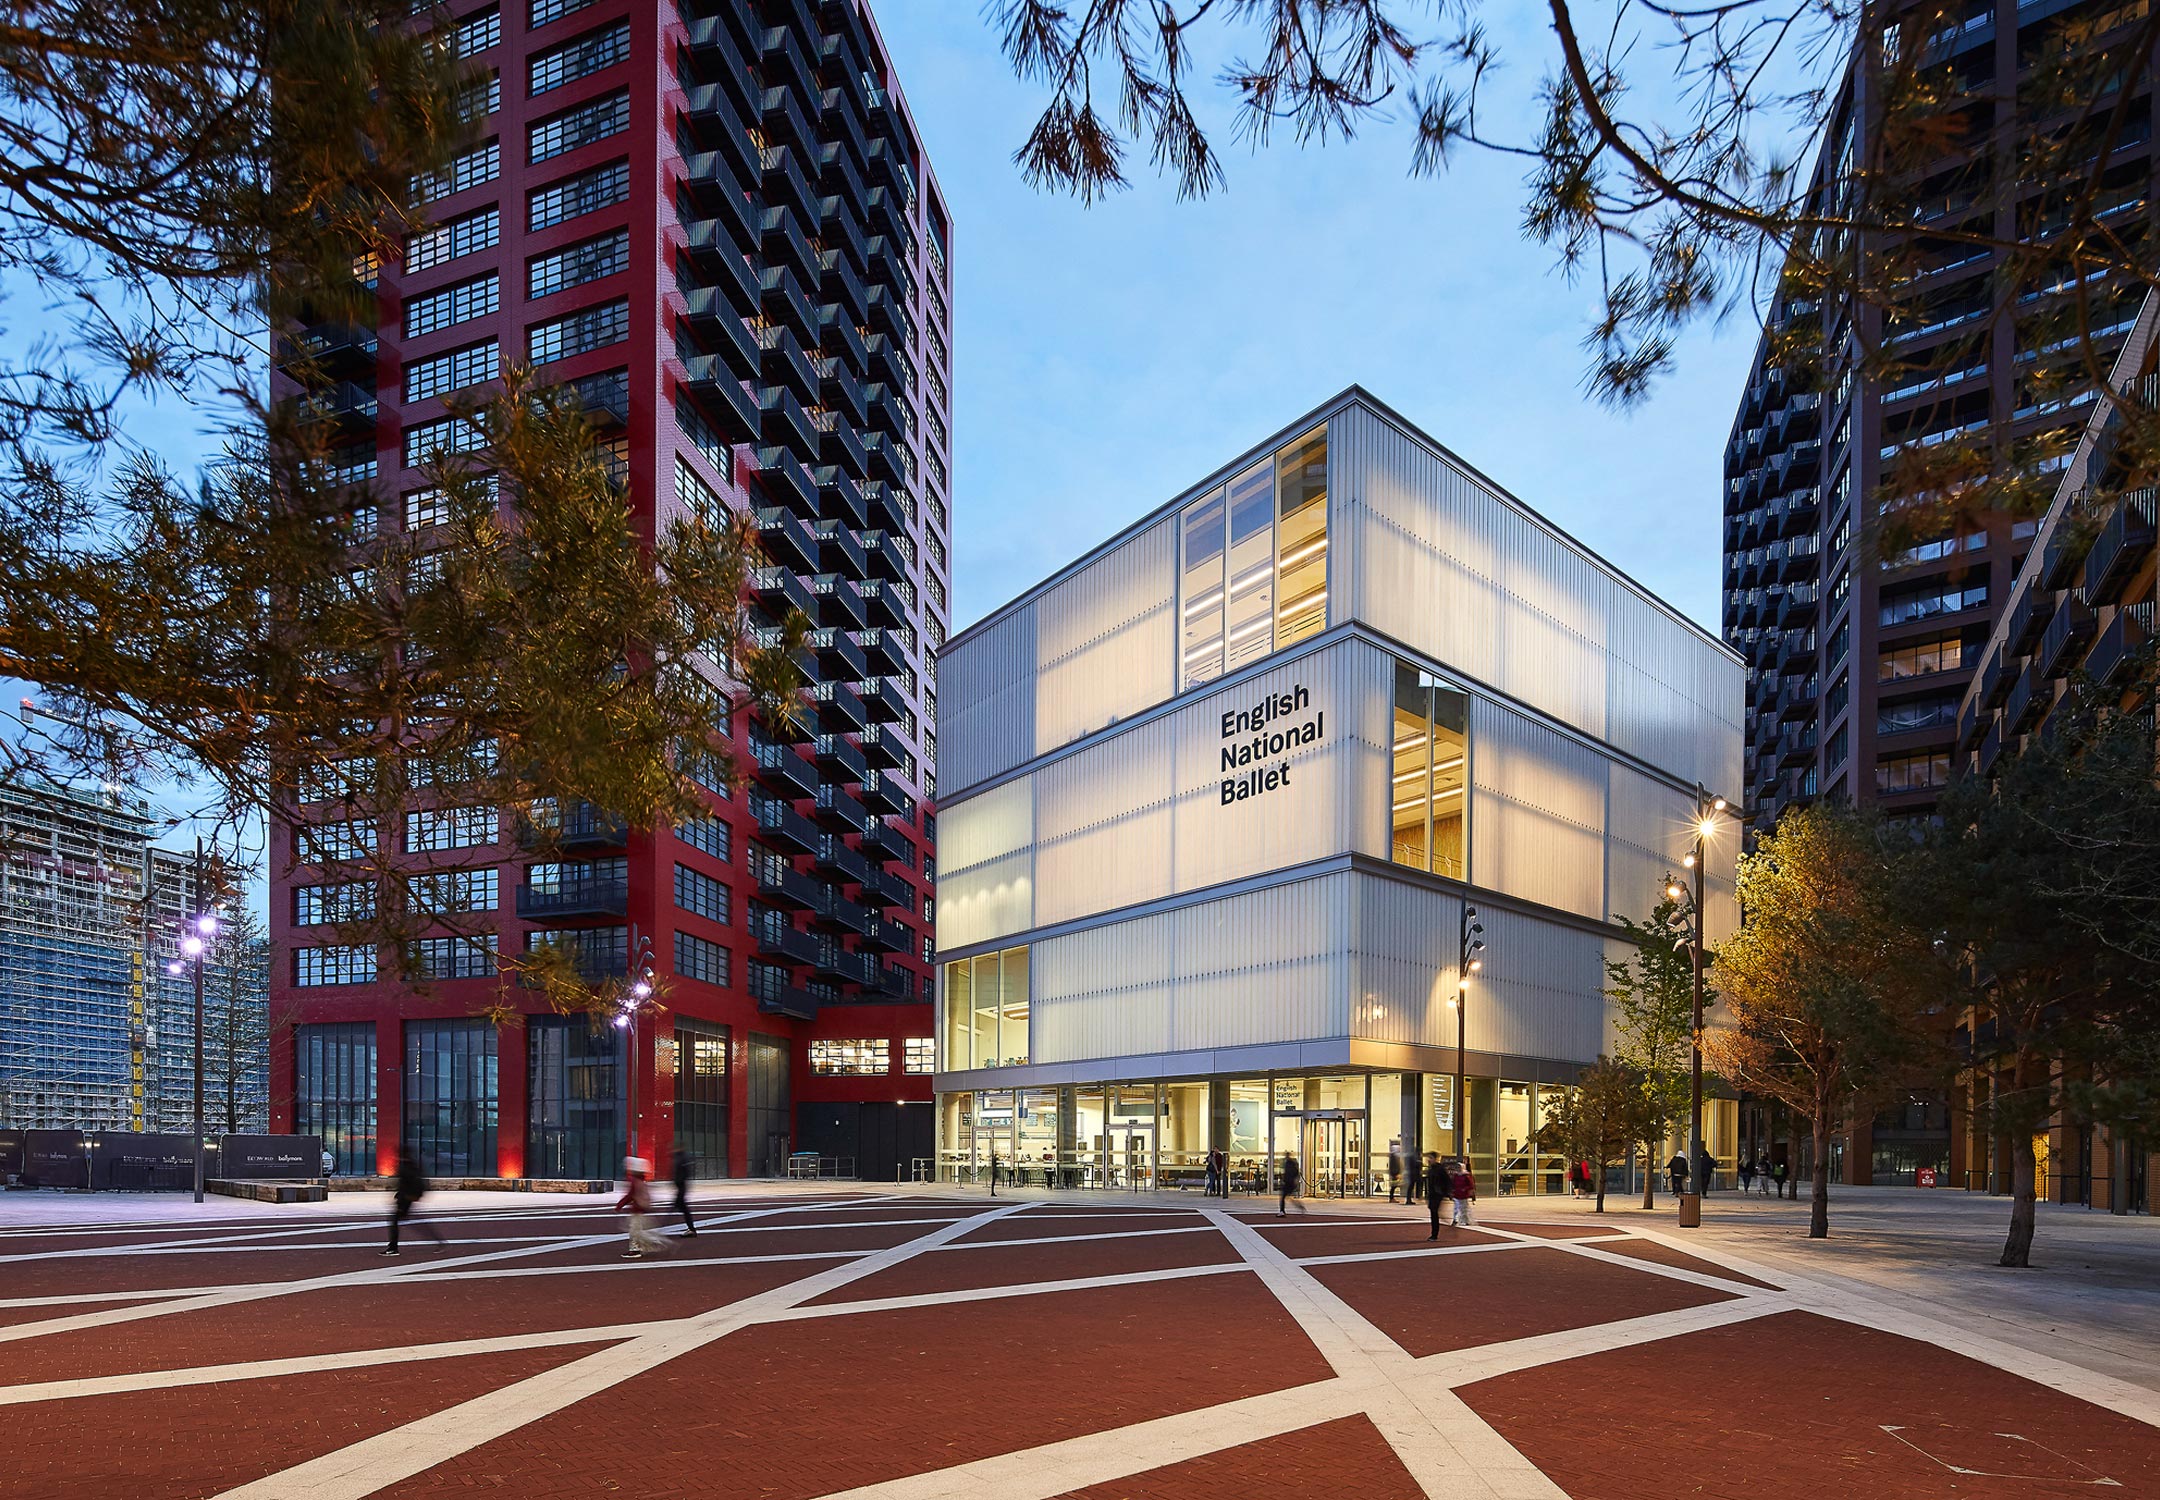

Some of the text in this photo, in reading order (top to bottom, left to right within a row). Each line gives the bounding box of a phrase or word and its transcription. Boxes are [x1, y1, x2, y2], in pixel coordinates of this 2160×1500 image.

[1221, 684, 1309, 739] English
[1221, 711, 1324, 773] National
[1221, 762, 1290, 806] Ballet
